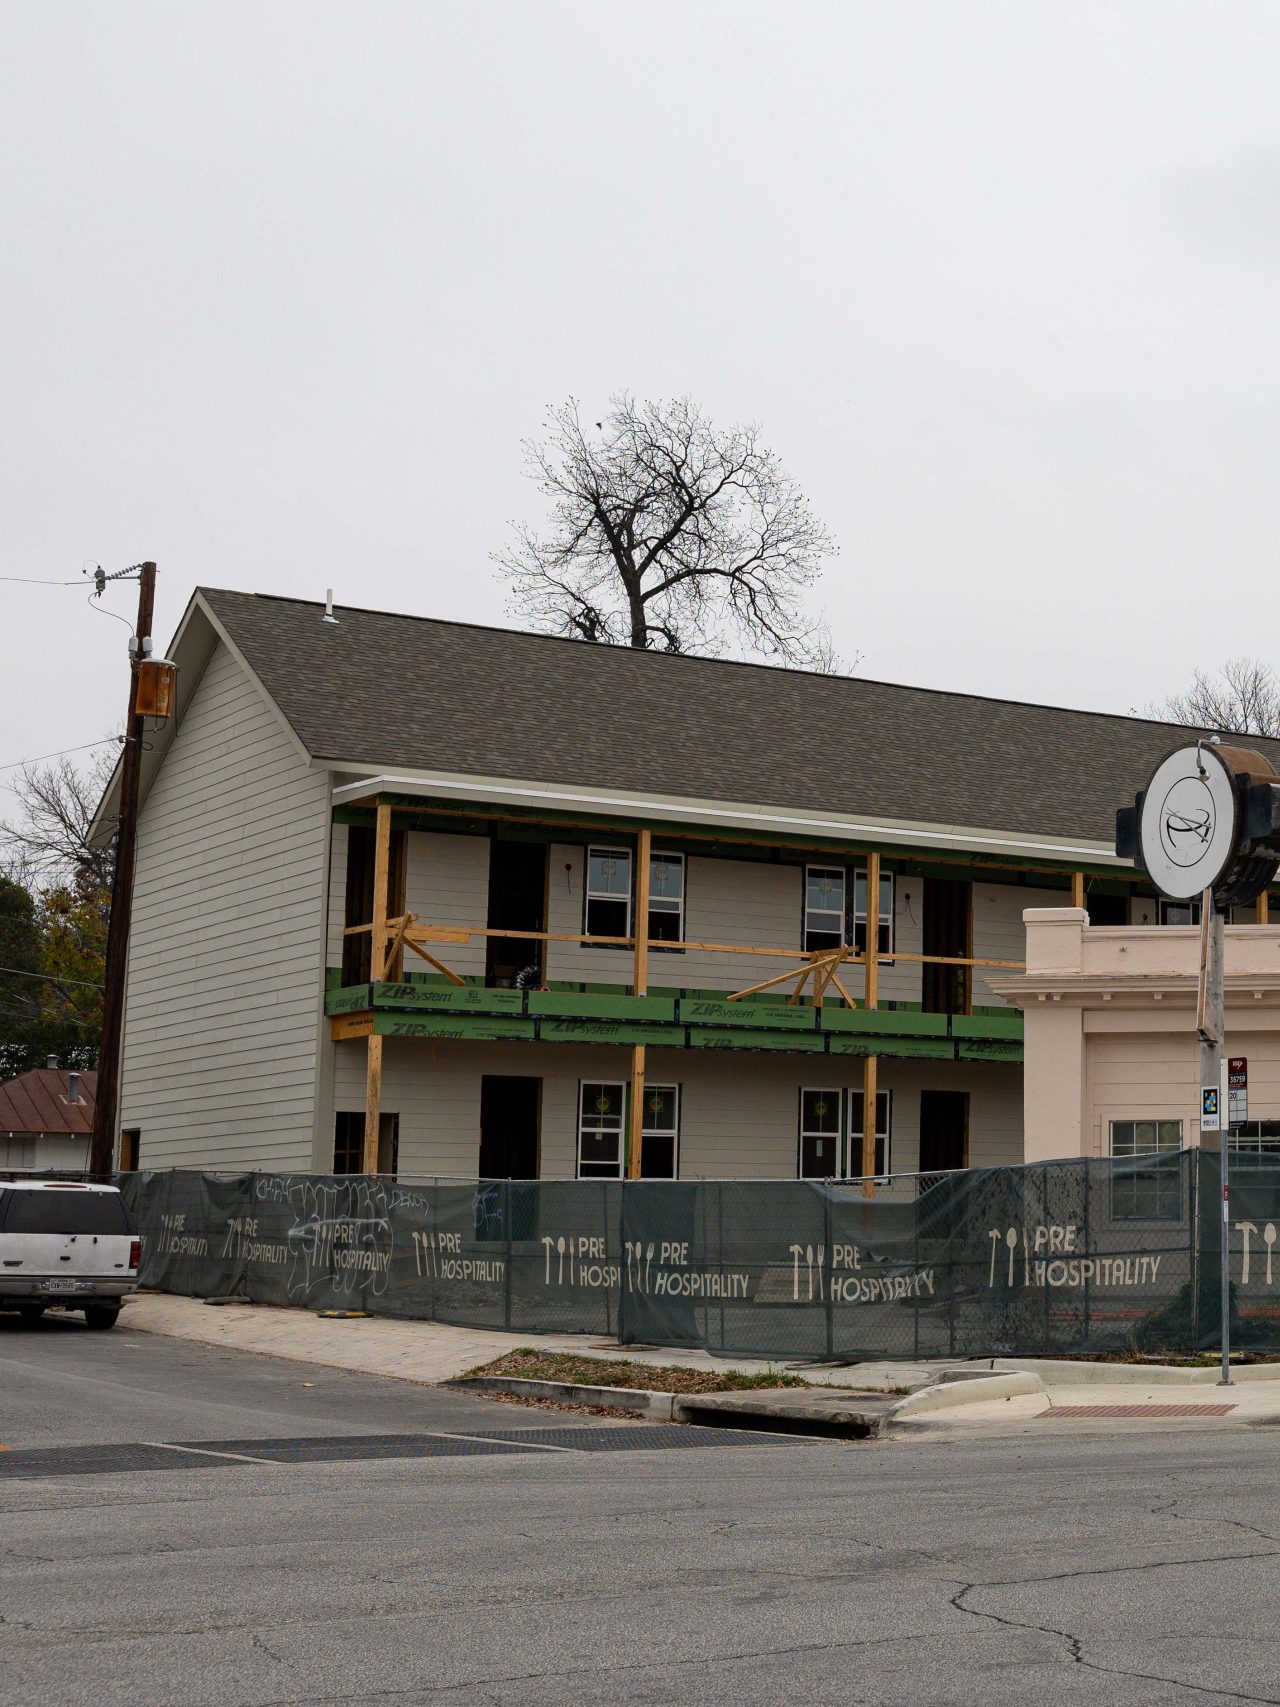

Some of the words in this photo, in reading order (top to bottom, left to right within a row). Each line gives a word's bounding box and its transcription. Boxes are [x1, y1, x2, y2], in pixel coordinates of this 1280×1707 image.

[334, 1224, 354, 1243] PRE
[439, 1233, 461, 1253] PRE
[1034, 1225, 1076, 1252] PRE
[579, 1237, 606, 1259] PRE
[660, 1243, 688, 1265] PRE
[832, 1245, 861, 1269] PRE
[333, 1249, 389, 1272] HOSPITALITY
[441, 1259, 505, 1282] HOSPITALITY
[1034, 1256, 1161, 1288] HOSPITALITY
[579, 1265, 621, 1287] HOSPI
[655, 1272, 749, 1298] HOSPITALITY
[830, 1270, 934, 1302] HOSPITALITY
